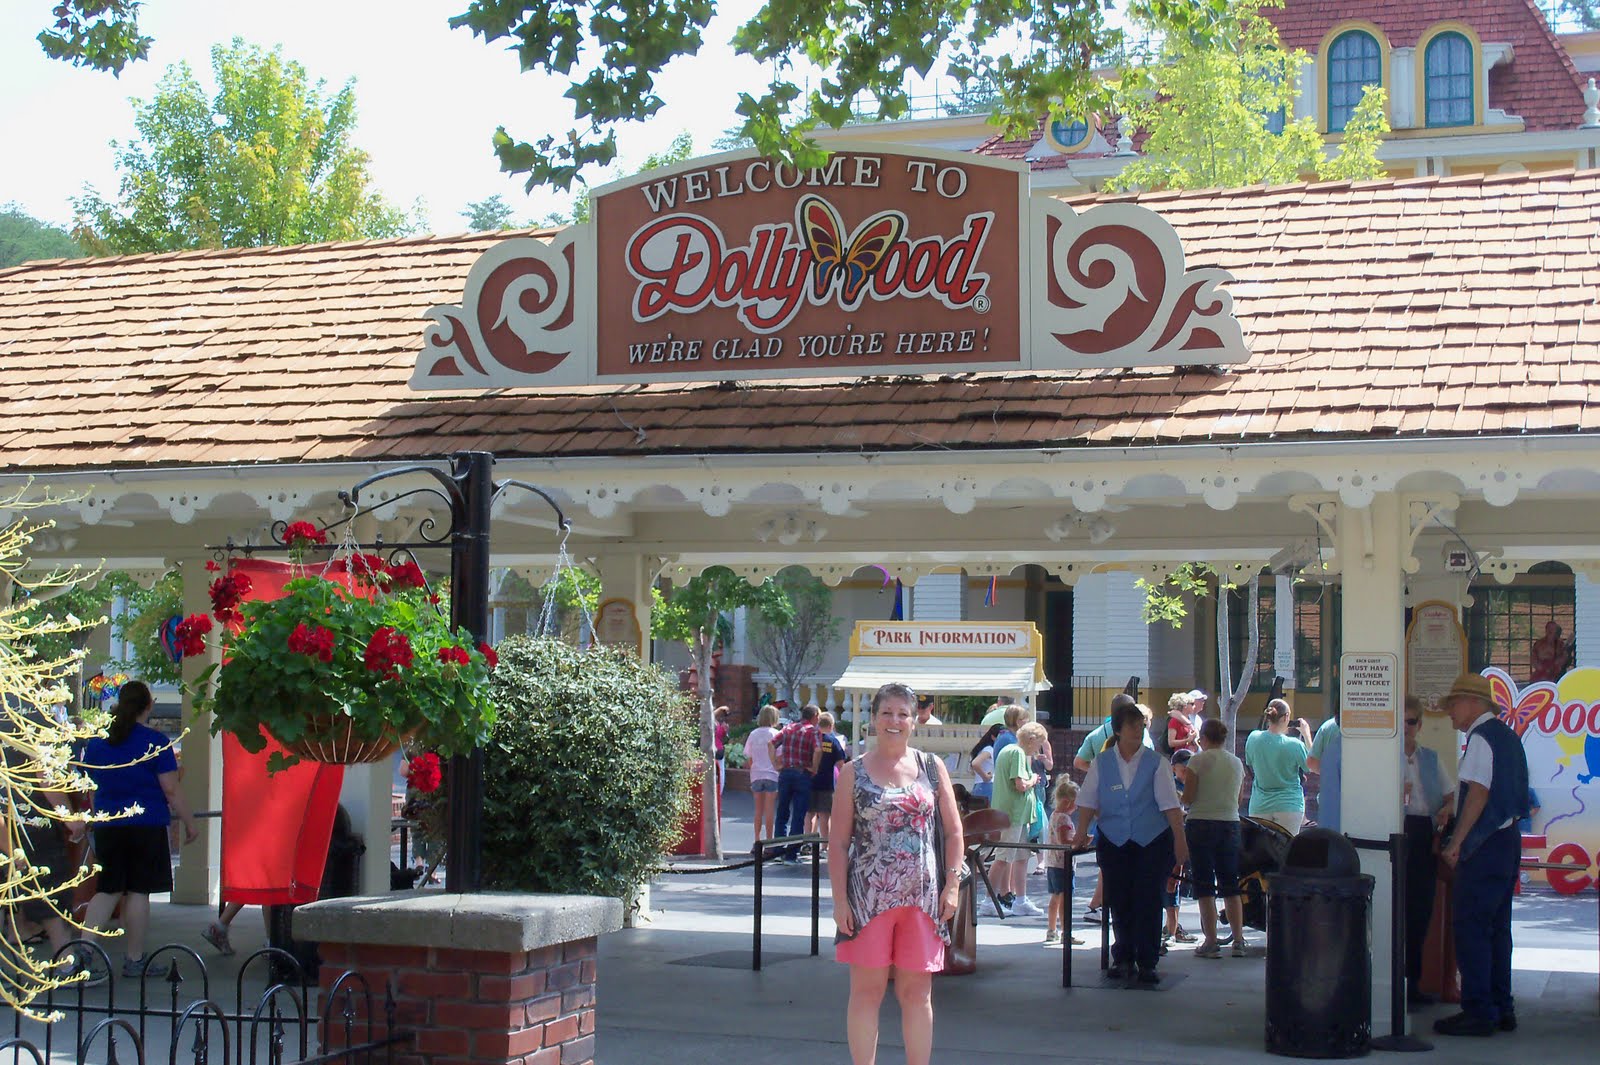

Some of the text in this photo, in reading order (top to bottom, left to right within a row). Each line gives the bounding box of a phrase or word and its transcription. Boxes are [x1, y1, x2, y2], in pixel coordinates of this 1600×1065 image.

[640, 156, 968, 213] WELCOME TO
[628, 332, 703, 364] WE'RE
[712, 337, 783, 360] GLAD
[798, 323, 886, 358] YOU'RE
[873, 630, 1016, 646] PARK INFORMATION
